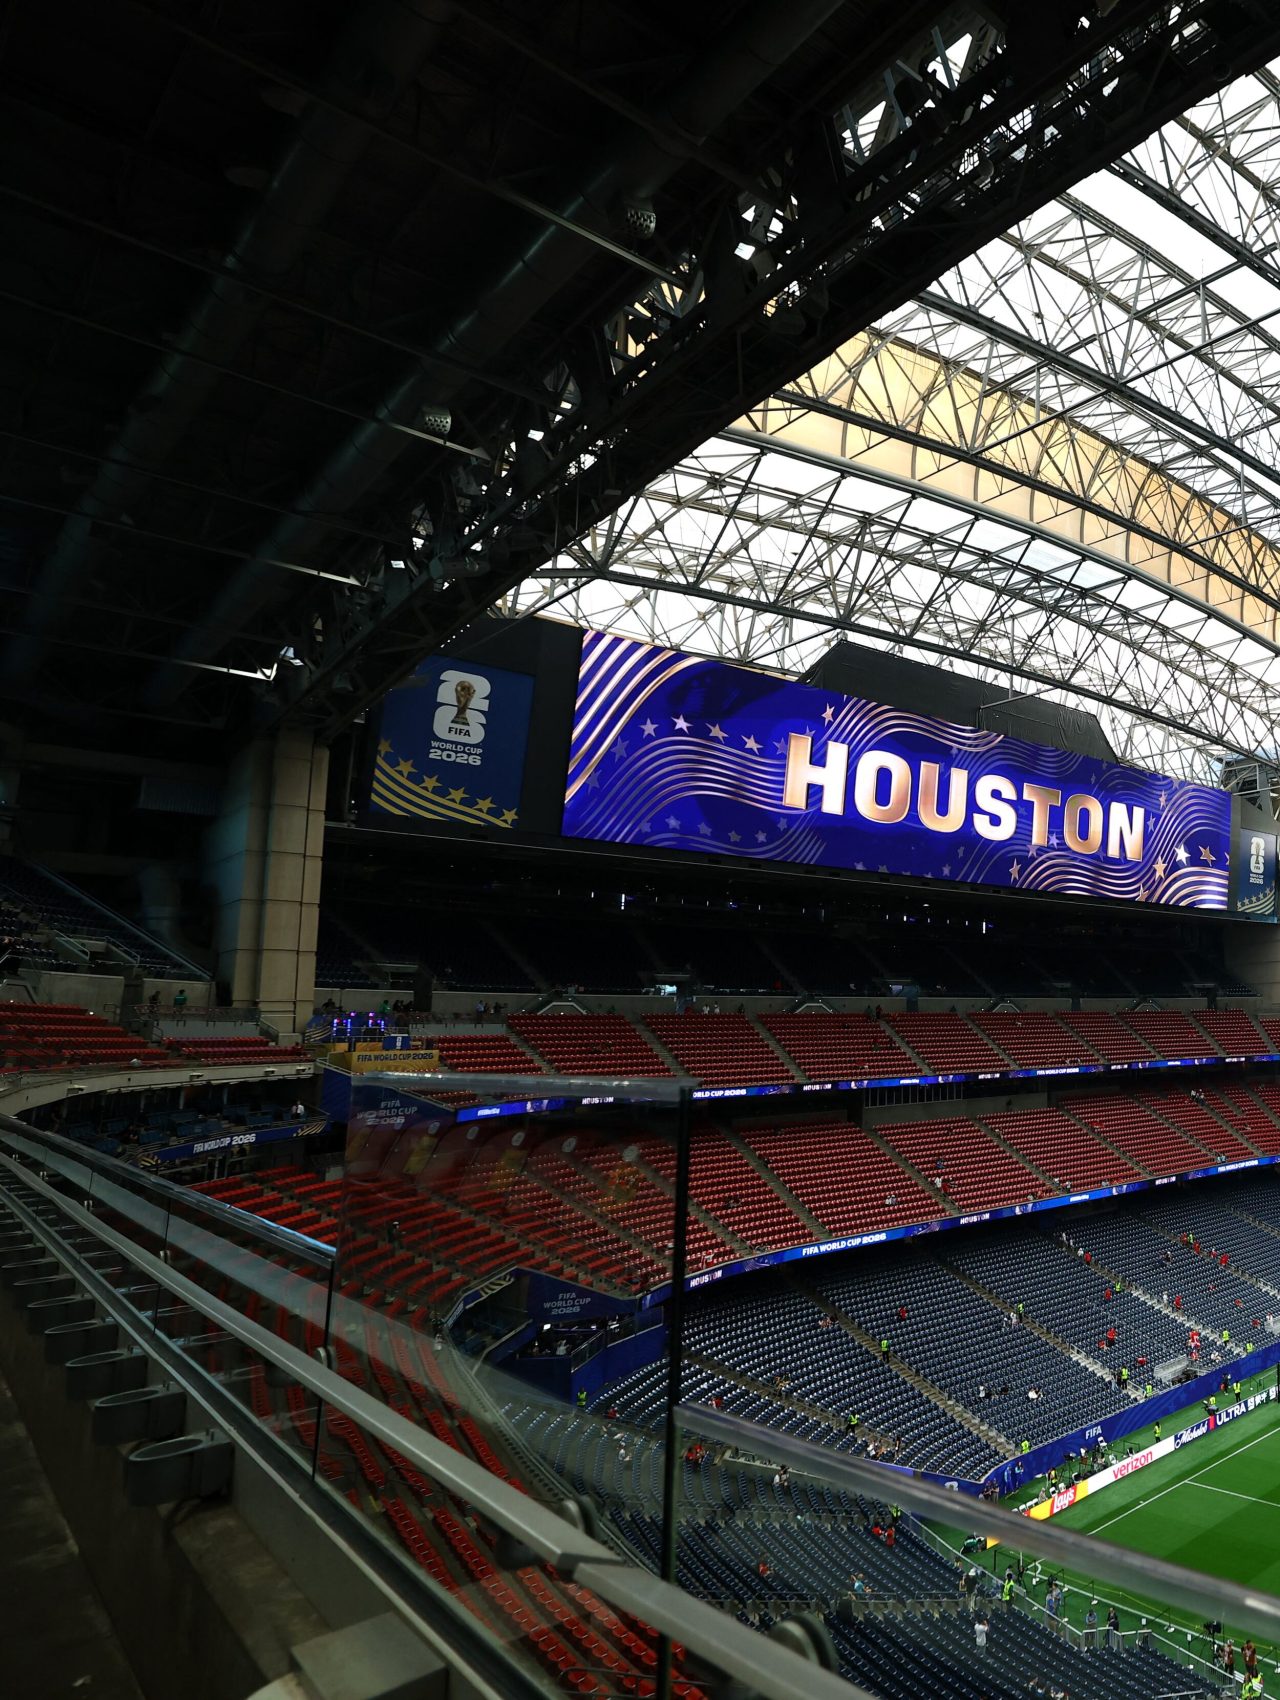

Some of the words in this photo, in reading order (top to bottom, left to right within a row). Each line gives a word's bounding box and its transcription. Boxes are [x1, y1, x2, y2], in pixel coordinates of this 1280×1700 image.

[448, 726, 471, 738] FIFA
[431, 740, 464, 752] WORLD
[465, 746, 483, 755] CUP
[429, 748, 482, 766] 2026
[783, 732, 1145, 862] HOUSTON
[357, 1054, 372, 1062] FIFA
[374, 1054, 397, 1062] WORLD
[398, 1053, 411, 1061] CUP
[412, 1052, 434, 1060] 2026
[724, 1088, 747, 1096] 2026
[803, 1083, 832, 1091] HOUSTON
[381, 1100, 400, 1108] FIFA
[582, 1096, 614, 1105] HOUSTON
[398, 1106, 418, 1116] CUP
[960, 1213, 990, 1225] HOUSTON
[802, 1246, 819, 1256] FIFA
[819, 1240, 847, 1253] WORLD
[847, 1237, 862, 1248] CUP
[862, 1232, 887, 1244] 2026
[690, 1269, 723, 1288] HOUSTON
[559, 1292, 577, 1300] FIFA
[543, 1299, 574, 1309] WORLD
[574, 1298, 591, 1306] CUP
[551, 1306, 580, 1315] 2026
[1216, 1402, 1247, 1426] ULTRA
[1085, 1425, 1102, 1440] FIFA
[1113, 1450, 1153, 1480] verizon
